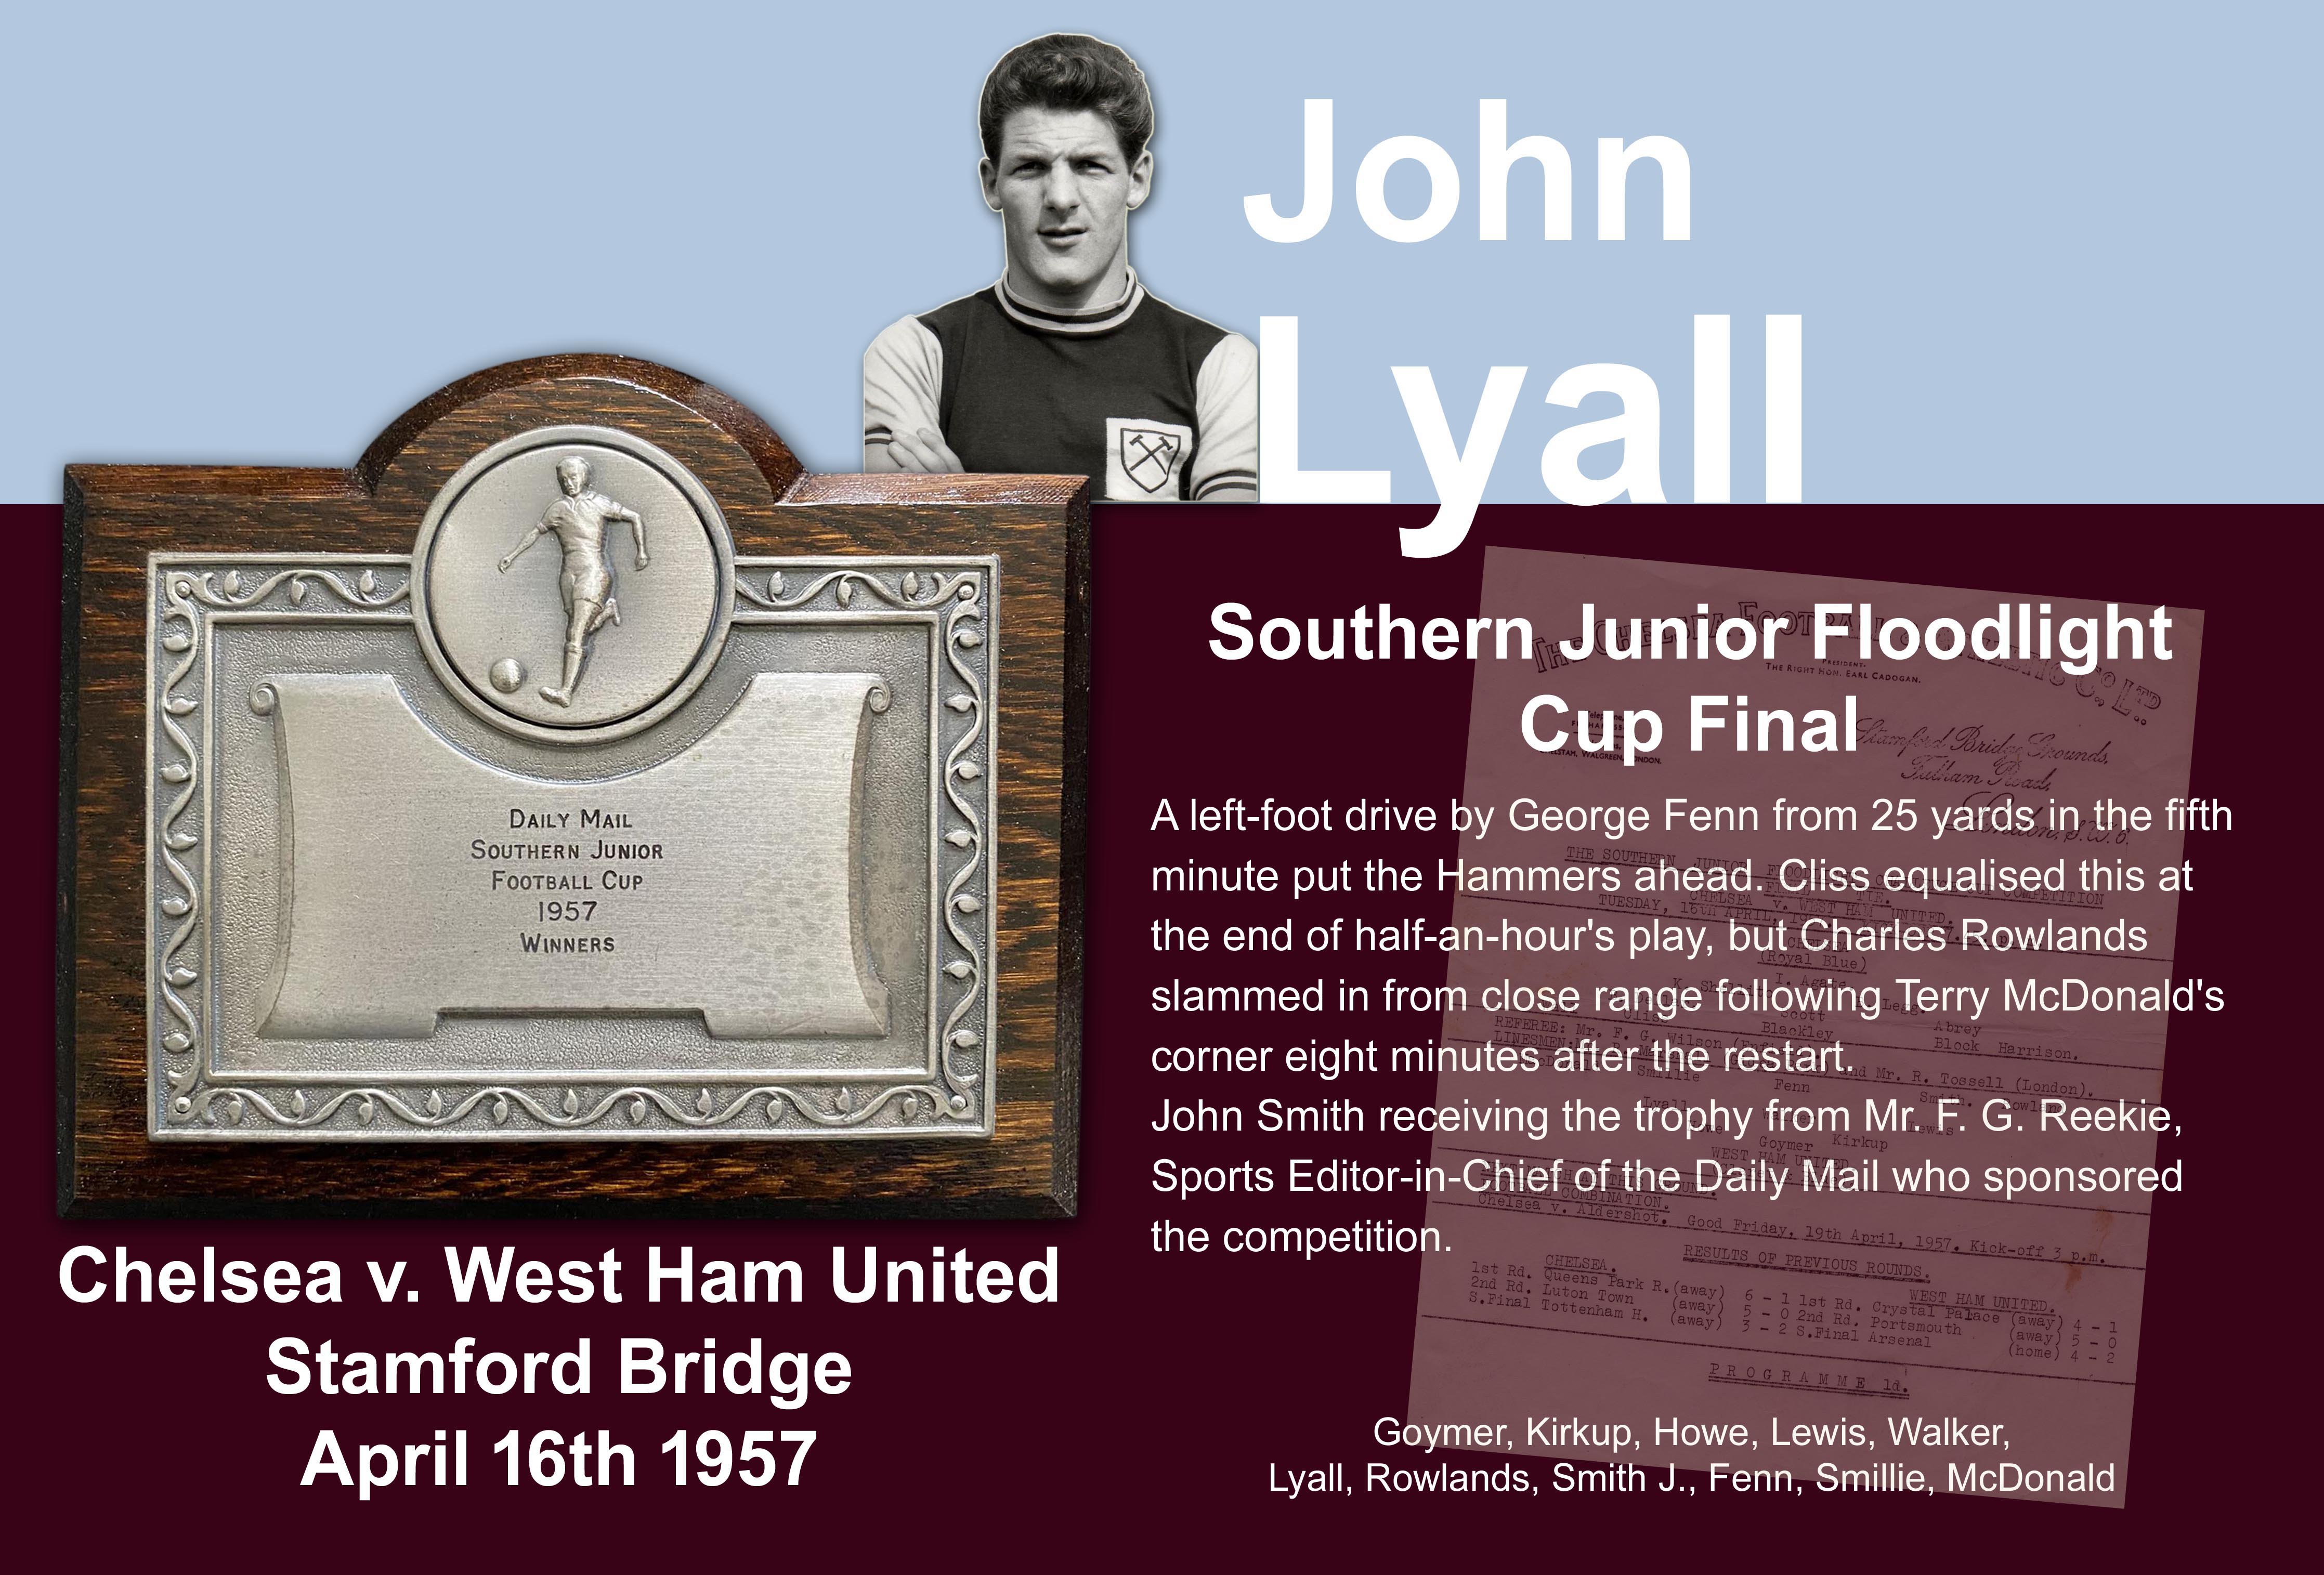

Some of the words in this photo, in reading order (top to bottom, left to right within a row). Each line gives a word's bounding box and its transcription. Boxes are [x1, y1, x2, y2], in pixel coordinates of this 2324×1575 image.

[539, 901, 597, 922] 1957
[1934, 1020, 1982, 1038] Abrey
[1934, 1037, 1980, 1051] Block
[1999, 1042, 2078, 1060] Harrison.
[1941, 1073, 2003, 1088] Tossell
[1832, 1134, 1888, 1152] Kirkup
[1544, 1268, 1598, 1285] Queens
[1609, 1276, 1643, 1290] Park
[1543, 1284, 1594, 1301] Luton
[1598, 1290, 1634, 1304] Town
[1873, 1302, 1935, 1317] Crystal
[1946, 1307, 2000, 1323] Palace
[1871, 1317, 1962, 1335] Portsmouth
[1868, 1331, 1931, 1348] Arsenal
